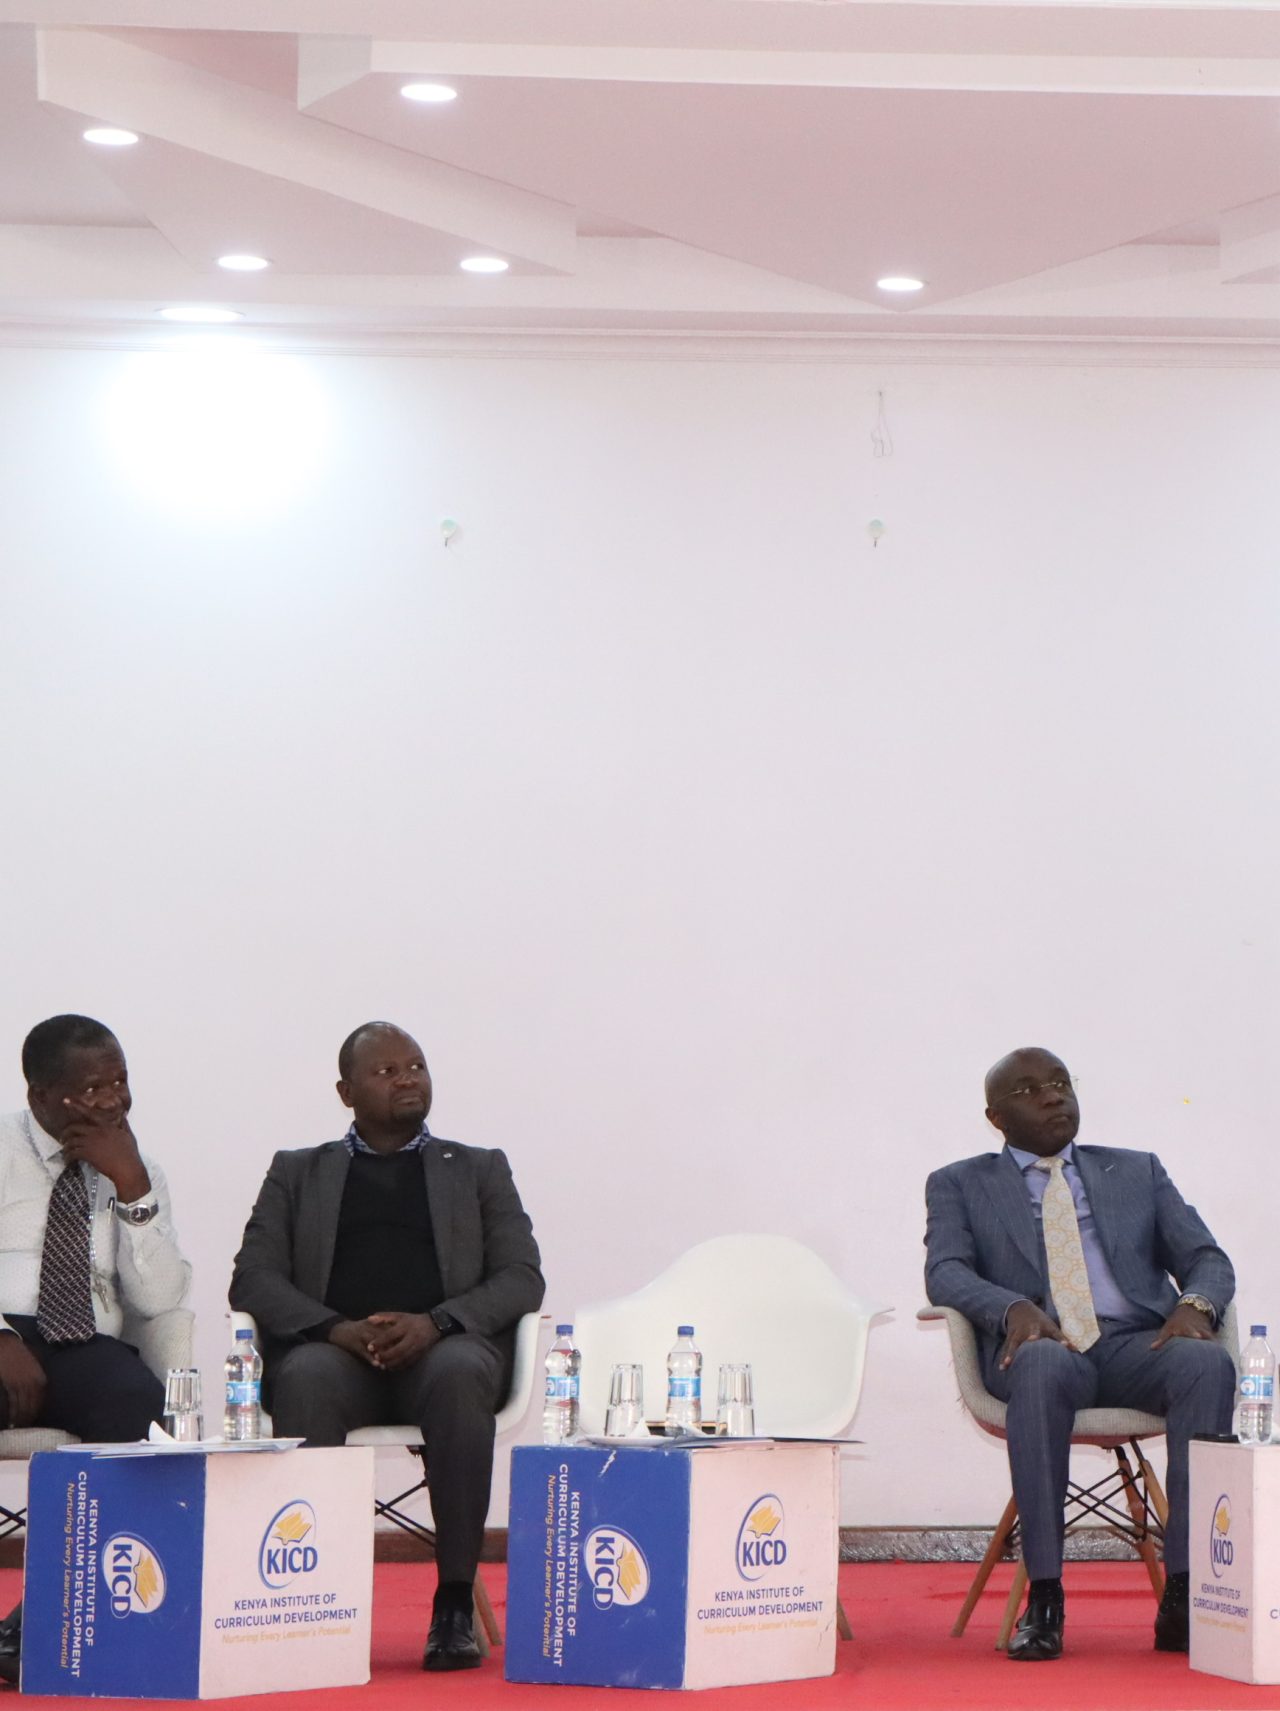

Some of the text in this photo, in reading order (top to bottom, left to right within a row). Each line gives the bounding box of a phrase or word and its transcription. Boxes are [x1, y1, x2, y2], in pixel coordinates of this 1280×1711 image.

[64, 1482, 75, 1534] Nurturing
[545, 1474, 556, 1525] Nurturing
[63, 1537, 73, 1566] Every
[267, 1546, 318, 1574] KICD
[544, 1527, 555, 1557] Every
[553, 1463, 568, 1667] CURRICULUM DEVELOPMENT
[567, 1491, 580, 1636] KENYA INSTITUTE OF
[742, 1539, 787, 1567] KICD
[1213, 1538, 1233, 1566] KICD
[71, 1471, 87, 1678] CURRICULUM DEVELOPMENT
[85, 1499, 99, 1646] KENYA INSTITUTE OF
[112, 1544, 132, 1618] KICD
[594, 1536, 615, 1610] KICD
[715, 1586, 804, 1602] KENYA INSTITUTE OF
[214, 1608, 358, 1629] CURRICULUM DEVELOPMENT
[234, 1593, 337, 1611] KENYA INSTITUTE OF
[697, 1601, 823, 1620] CURRICULUM DEVELOPMENT
[60, 1620, 70, 1668] Potential
[543, 1610, 552, 1657] Potential
